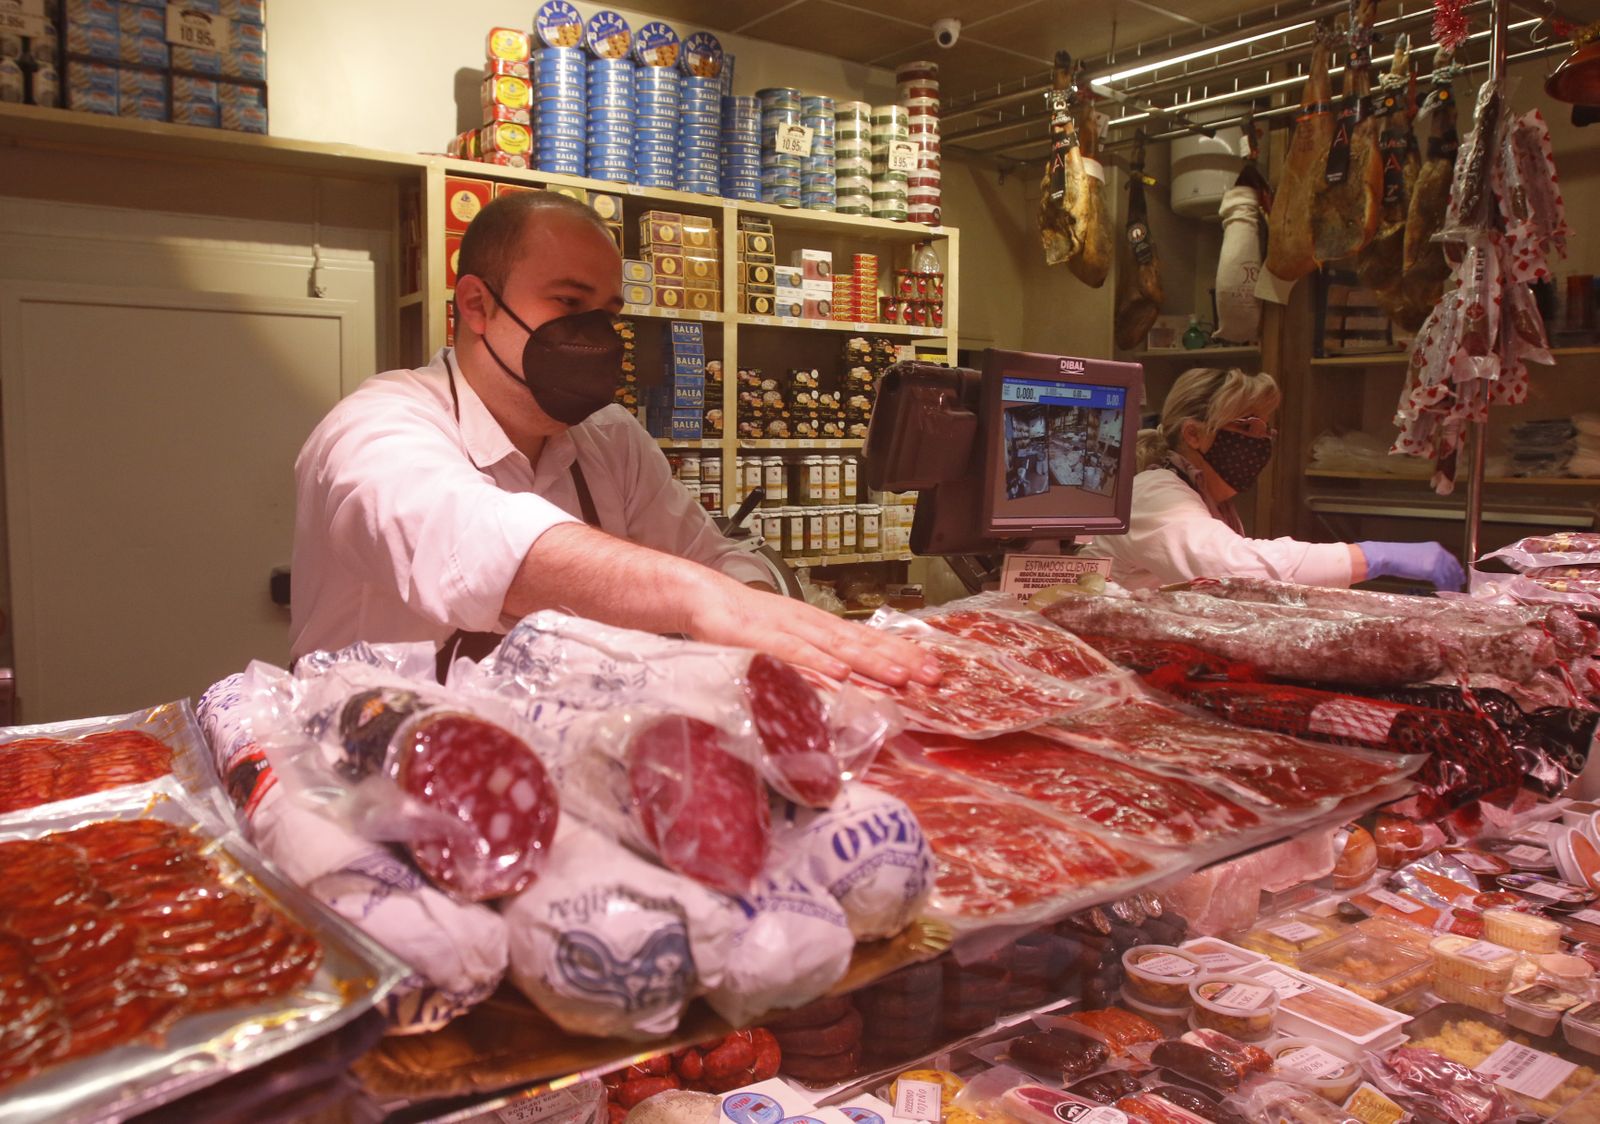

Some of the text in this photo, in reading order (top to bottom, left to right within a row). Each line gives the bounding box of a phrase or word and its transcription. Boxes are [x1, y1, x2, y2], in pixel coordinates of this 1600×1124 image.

[538, 1, 577, 25] BALEA
[590, 13, 623, 40] BALEA
[640, 24, 674, 48] BALEA
[656, 108, 675, 116] BALEA
[557, 128, 578, 136] BALEA
[609, 124, 630, 132] BALEA
[612, 136, 631, 144] BALEA
[655, 145, 674, 153] BALEA
[652, 156, 672, 164] BALEA
[702, 152, 718, 160] BALEA
[655, 168, 673, 176] BALEA
[700, 174, 717, 182] BALEA
[674, 325, 700, 334] BALEA
[677, 357, 702, 365] BALEA
[1061, 360, 1085, 370] DIBAL
[677, 389, 702, 397] BALEA
[674, 421, 700, 430] BALEA
[1025, 560, 1098, 573] ESTIMADOS CLIENTES
